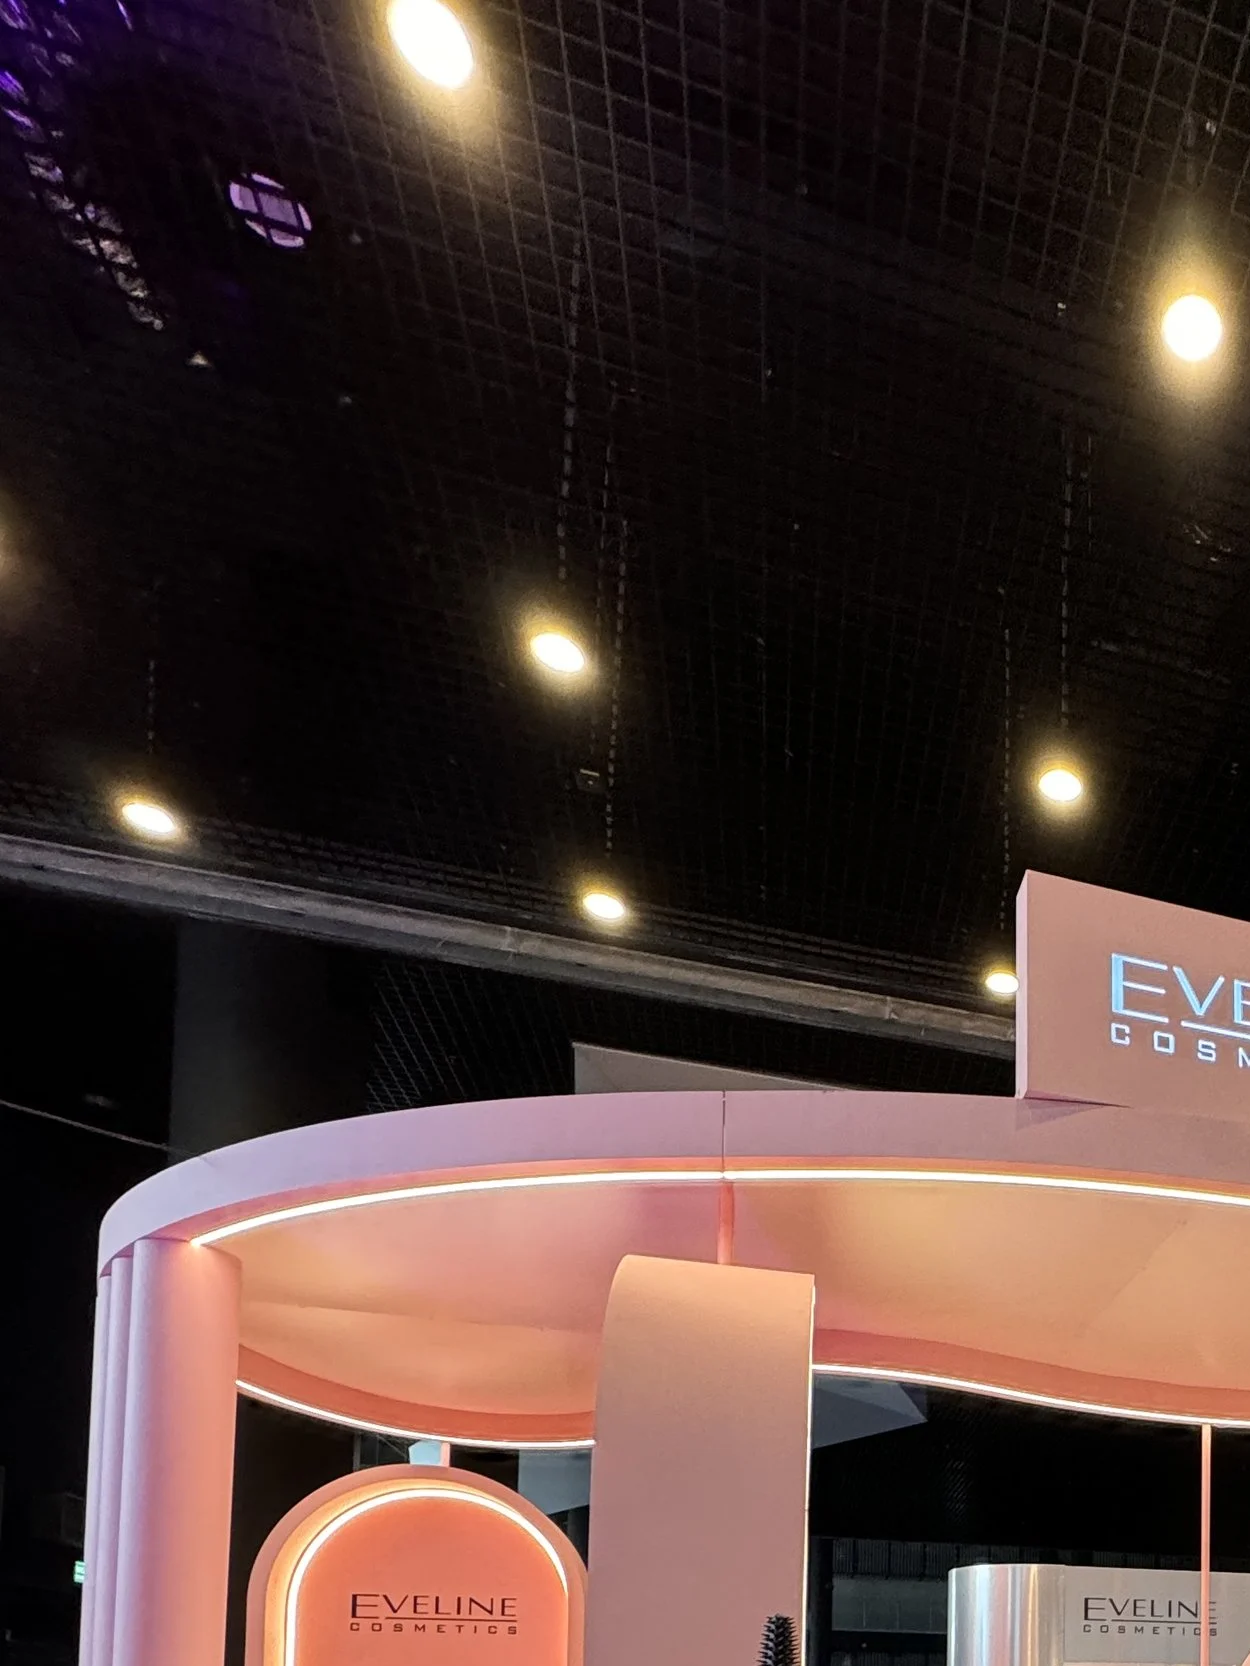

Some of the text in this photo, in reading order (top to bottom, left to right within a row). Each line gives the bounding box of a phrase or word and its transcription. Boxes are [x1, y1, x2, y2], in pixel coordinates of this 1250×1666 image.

[351, 1593, 517, 1619] EVELINE
[350, 1622, 518, 1635] COSMETICS
[1083, 1624, 1217, 1637] COSMETICS
